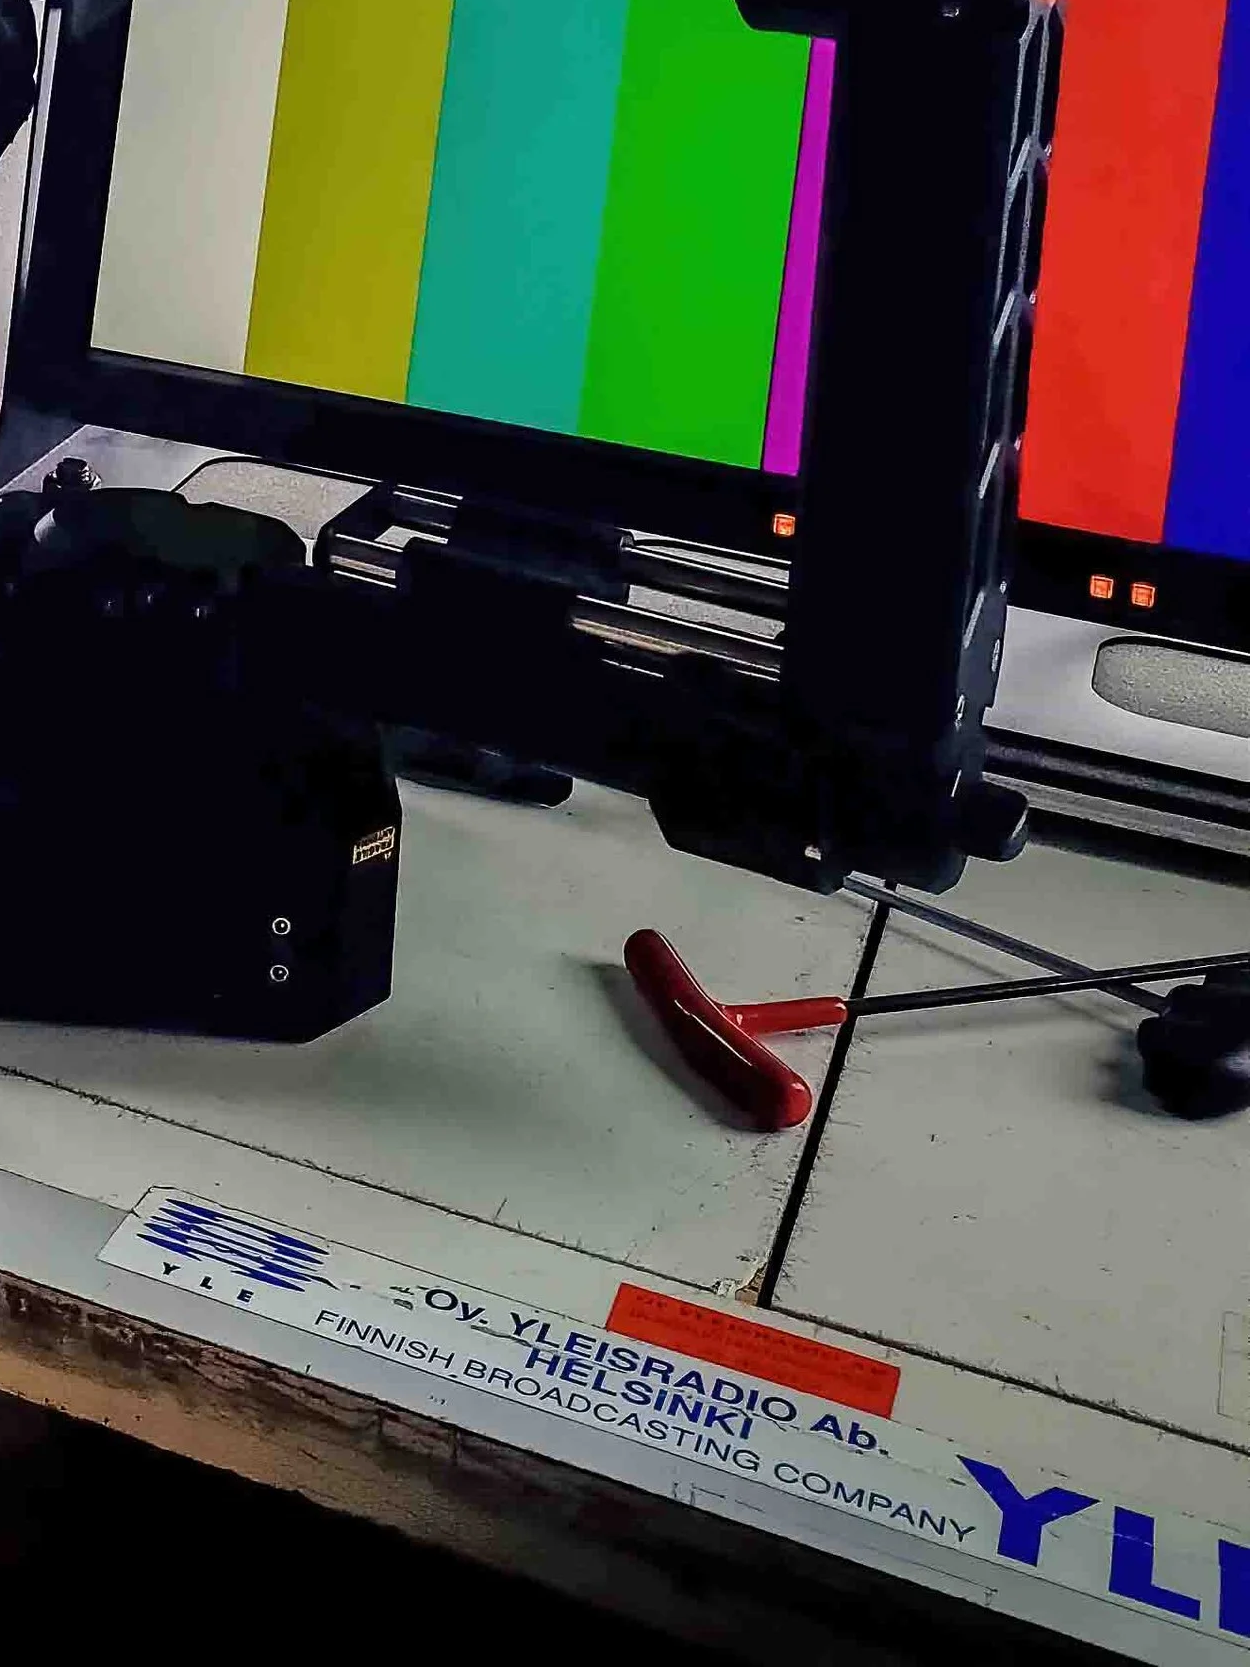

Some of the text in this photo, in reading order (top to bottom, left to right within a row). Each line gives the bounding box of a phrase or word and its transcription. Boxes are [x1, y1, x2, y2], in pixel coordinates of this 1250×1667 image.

[314, 1309, 976, 1542] FINNISH BROADCASTING COMPANY
[425, 1288, 889, 1455] Oy. YLEISRADIO Ab.
[525, 1349, 754, 1439] HELSINKI
